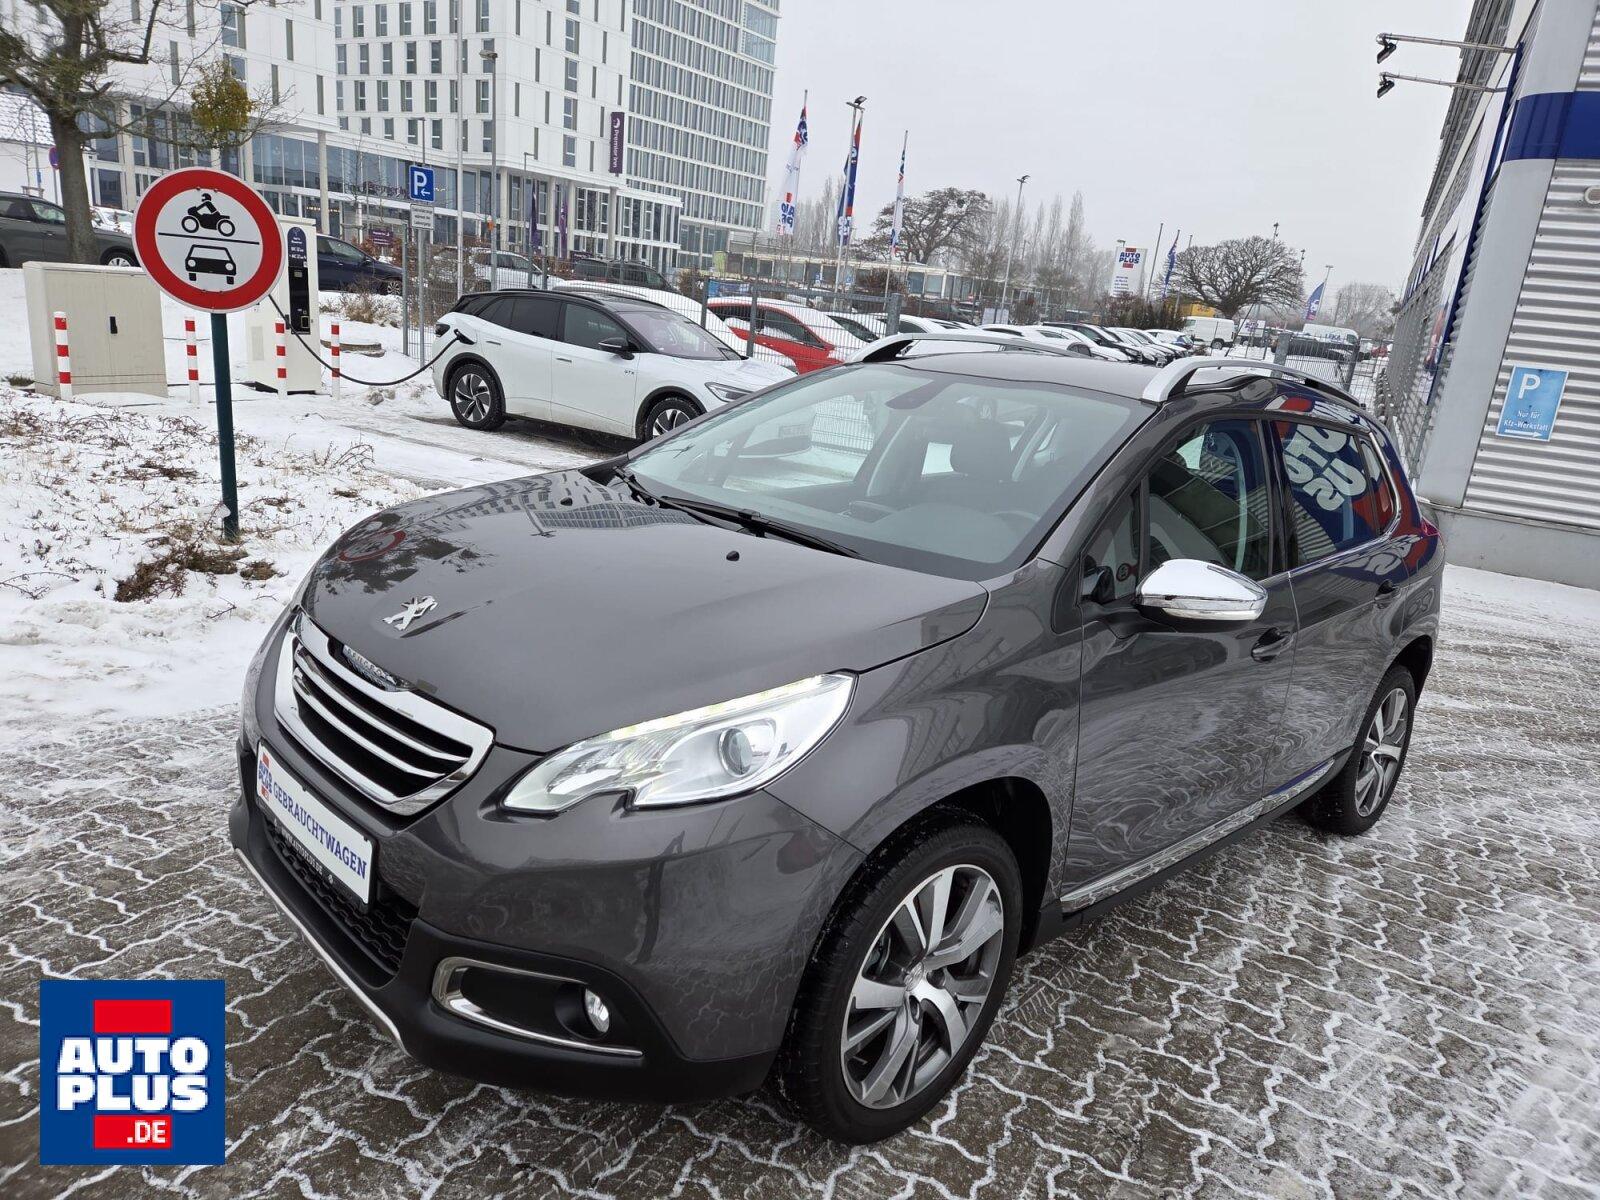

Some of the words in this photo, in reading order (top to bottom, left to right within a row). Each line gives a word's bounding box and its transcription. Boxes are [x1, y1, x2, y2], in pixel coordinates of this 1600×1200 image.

[414, 171, 427, 195] P
[1518, 374, 1540, 399] P
[1504, 419, 1548, 431] Kfz-Werkstatt
[1518, 410, 1529, 418] Nur
[273, 781, 368, 879] GEBRAUCHTWAGEN
